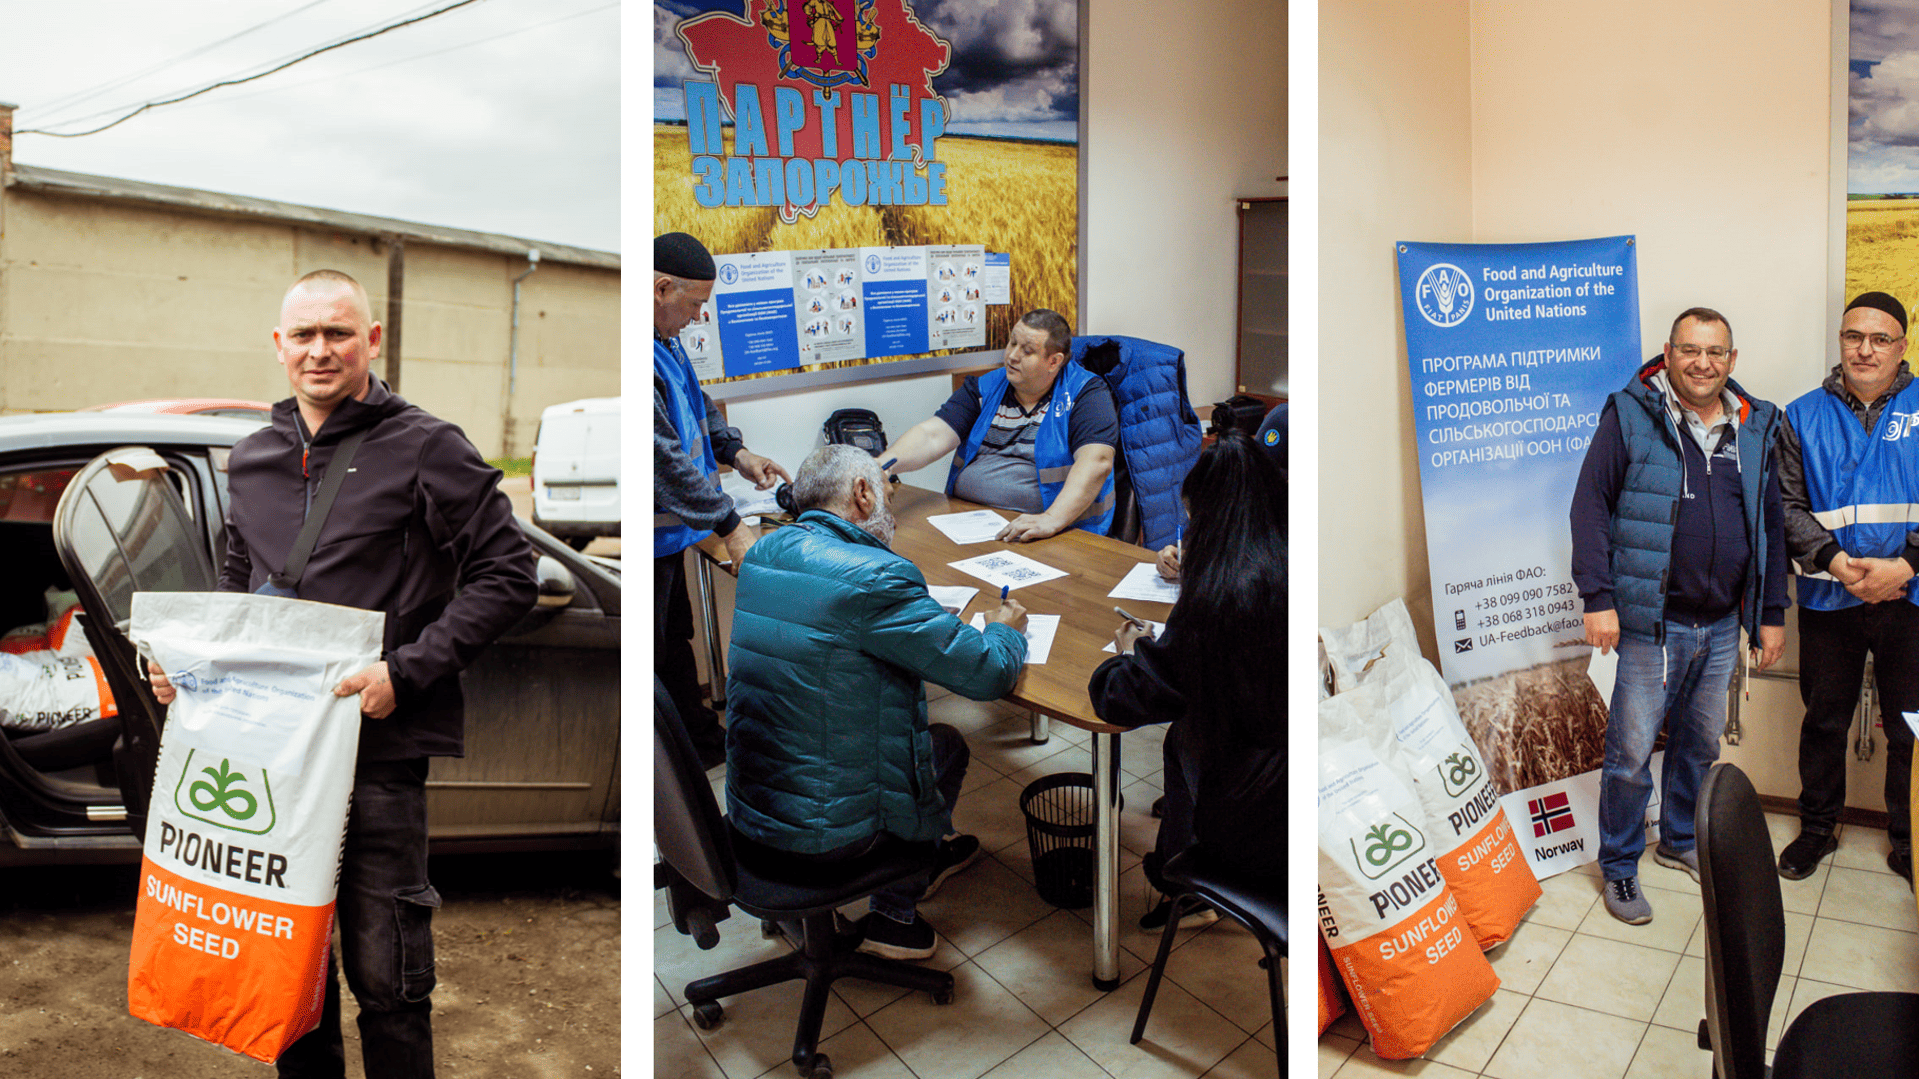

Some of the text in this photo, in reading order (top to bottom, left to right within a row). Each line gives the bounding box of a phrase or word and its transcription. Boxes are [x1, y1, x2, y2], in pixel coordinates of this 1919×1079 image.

[684, 80, 948, 162] ПАРТНЁР
[692, 155, 948, 208] ЗАПОРОЖЬЕ
[1421, 269, 1469, 299] FAO
[1483, 262, 1624, 281] Food and Agriculture
[1484, 282, 1615, 304] Organization of the
[1423, 299, 1471, 322] FIAT PANIS
[1486, 303, 1587, 321] United Nations
[1422, 346, 1601, 373] ПРОГРАМА ПІДТРИМКИ
[1424, 374, 1531, 397] ФЕРМЕРІВ ВІД
[1427, 392, 1571, 421] ПРОДОВОЛЬЧОЇ ТА
[1431, 441, 1524, 468] ОРГАНІЗАЦІЇ
[1527, 438, 1562, 456] ООН
[1445, 566, 1547, 595] Гаряча лінія ФАО:
[1474, 582, 1574, 611] +38 099 090 7582
[1477, 599, 1575, 629] +38 068 318 0943
[160, 820, 287, 889] PIONEER
[1491, 842, 1516, 875] SEED
[1534, 837, 1585, 862] Norway
[146, 874, 294, 939] SUNFLOWER
[173, 922, 240, 960] SEED
[1426, 926, 1462, 965] SEED
